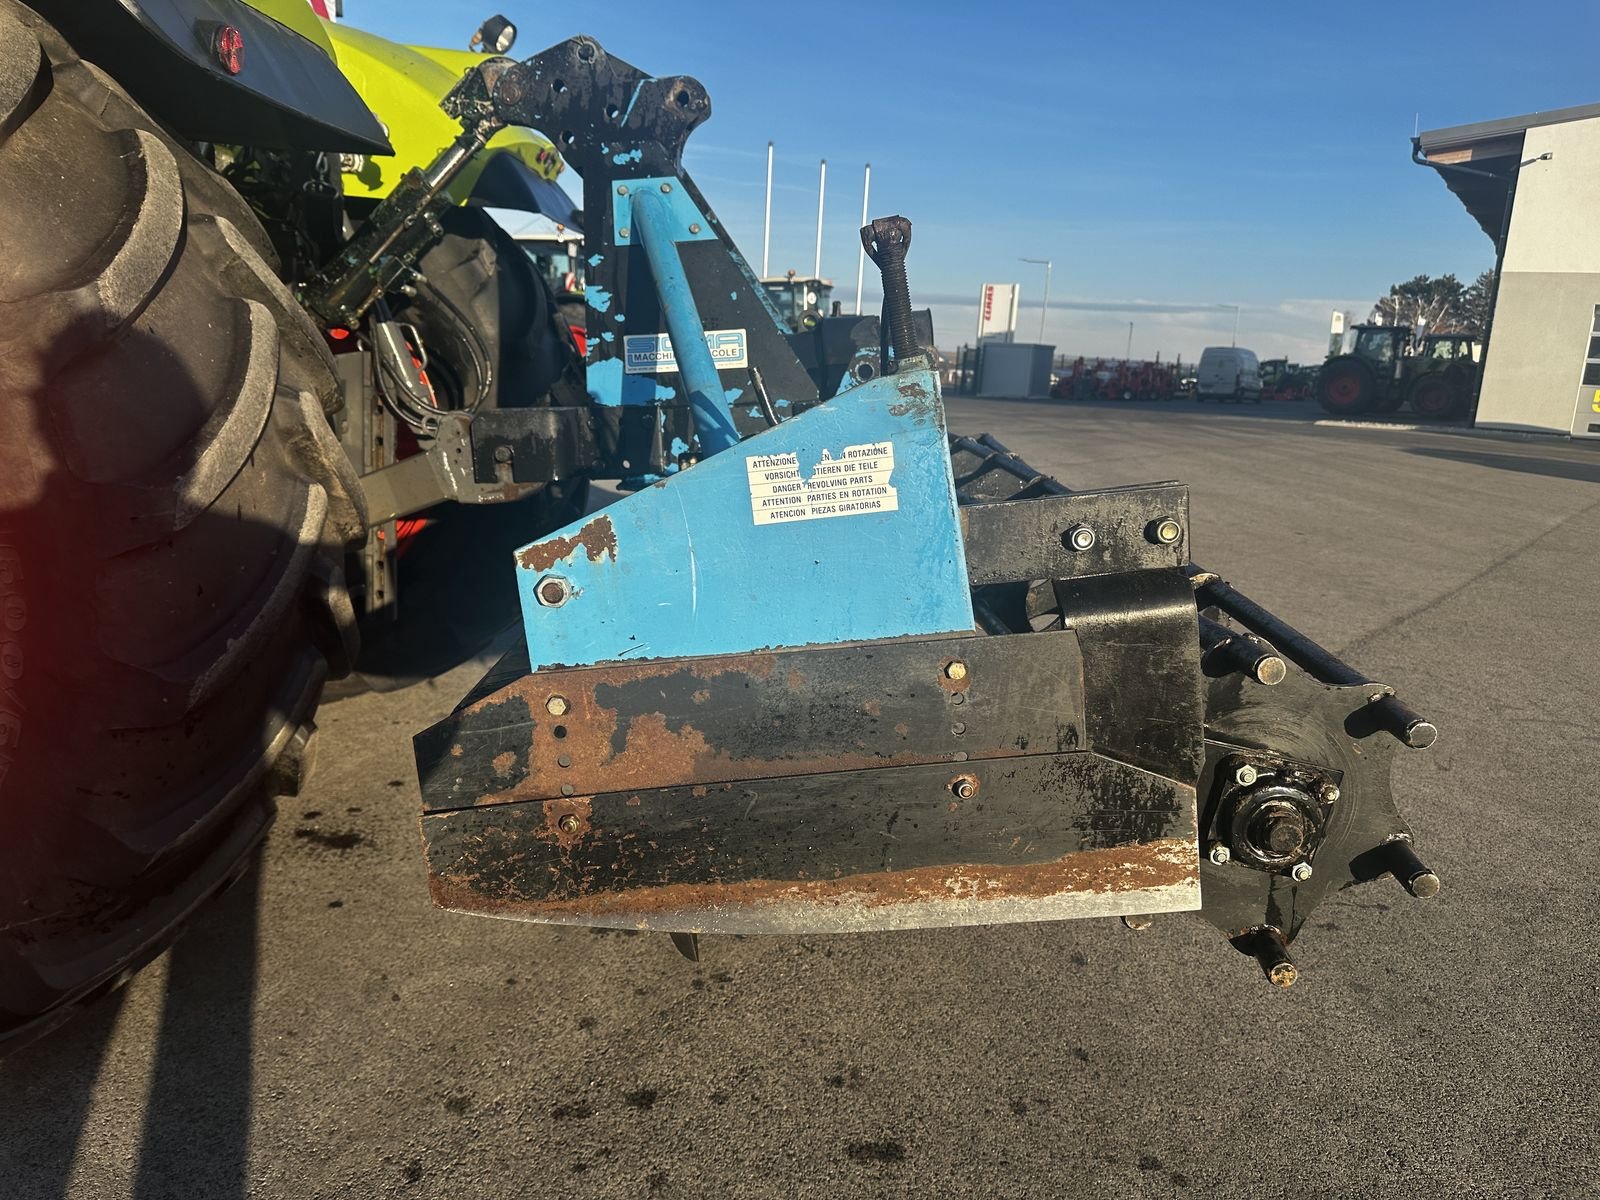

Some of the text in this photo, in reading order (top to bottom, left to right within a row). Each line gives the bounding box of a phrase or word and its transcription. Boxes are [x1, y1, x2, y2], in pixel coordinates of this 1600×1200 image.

[752, 456, 797, 468] ATTENZIONE
[848, 446, 888, 458] ROTAZIONE
[764, 469, 800, 480] VORSICHT
[844, 463, 856, 472] DIE
[858, 461, 878, 470] TEILE
[772, 475, 873, 493] DANGER REVOLVING PARTS
[762, 486, 887, 507] ATTENTION PARTIES EN ROTATION
[770, 500, 881, 519] ATENCION PIEZAS GIRATORIAS
